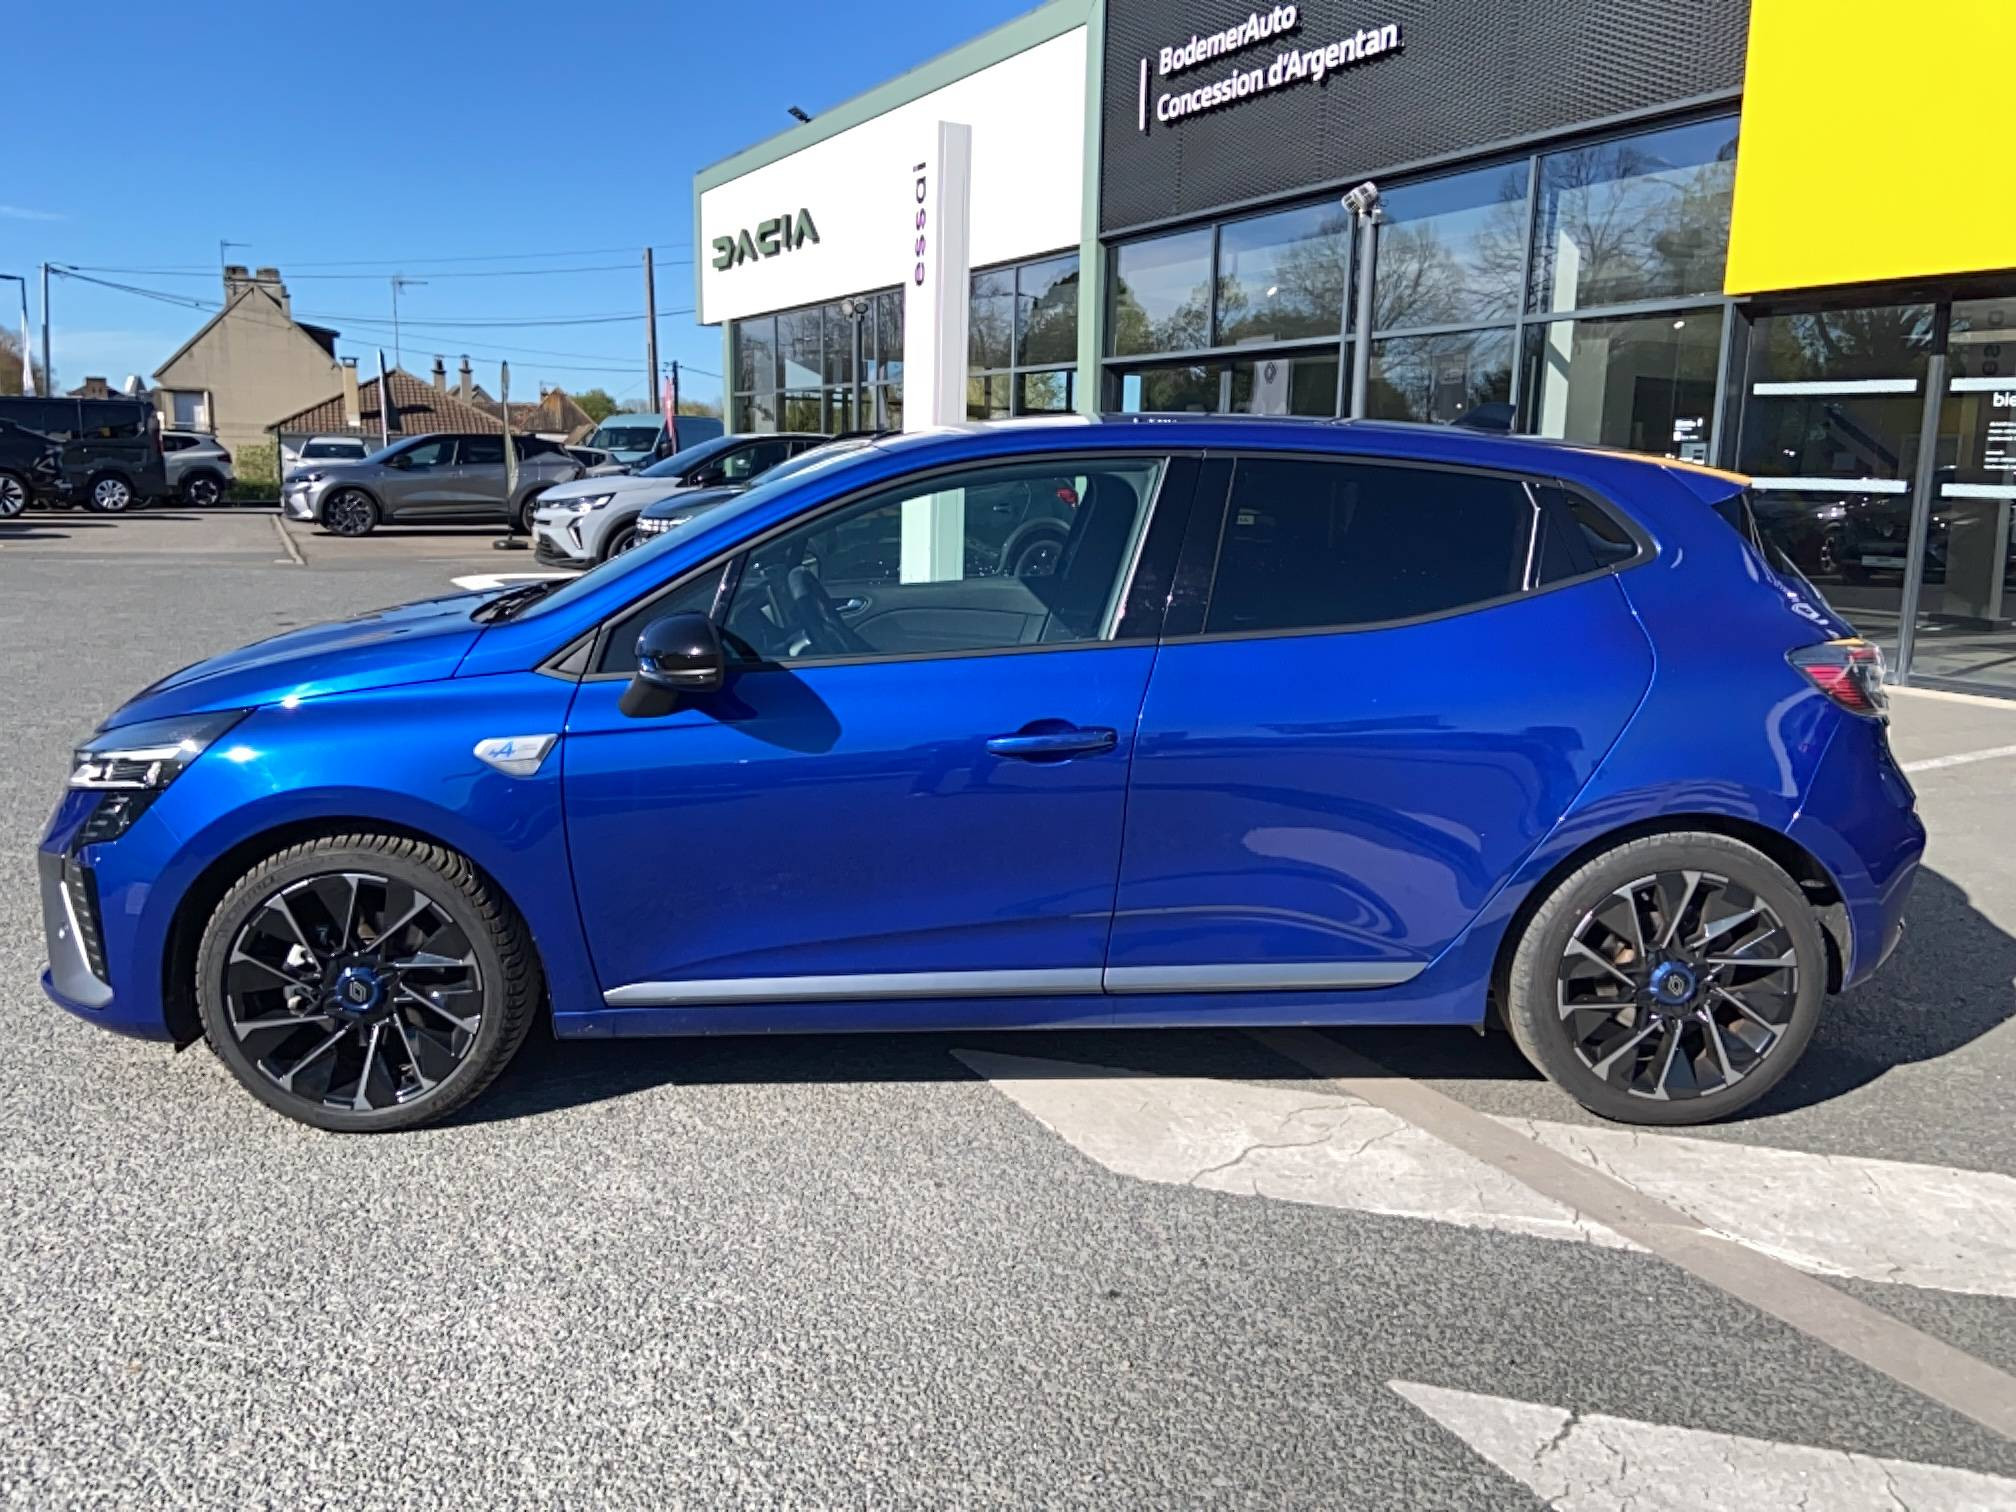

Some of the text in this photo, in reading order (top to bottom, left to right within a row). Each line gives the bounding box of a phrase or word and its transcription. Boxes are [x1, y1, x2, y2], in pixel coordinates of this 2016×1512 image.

[1156, 23, 1398, 122] Concession d'Argentan
[1158, 5, 1297, 75] BodemerAuto
[712, 208, 820, 272] DACIA
[912, 161, 927, 286] essai
